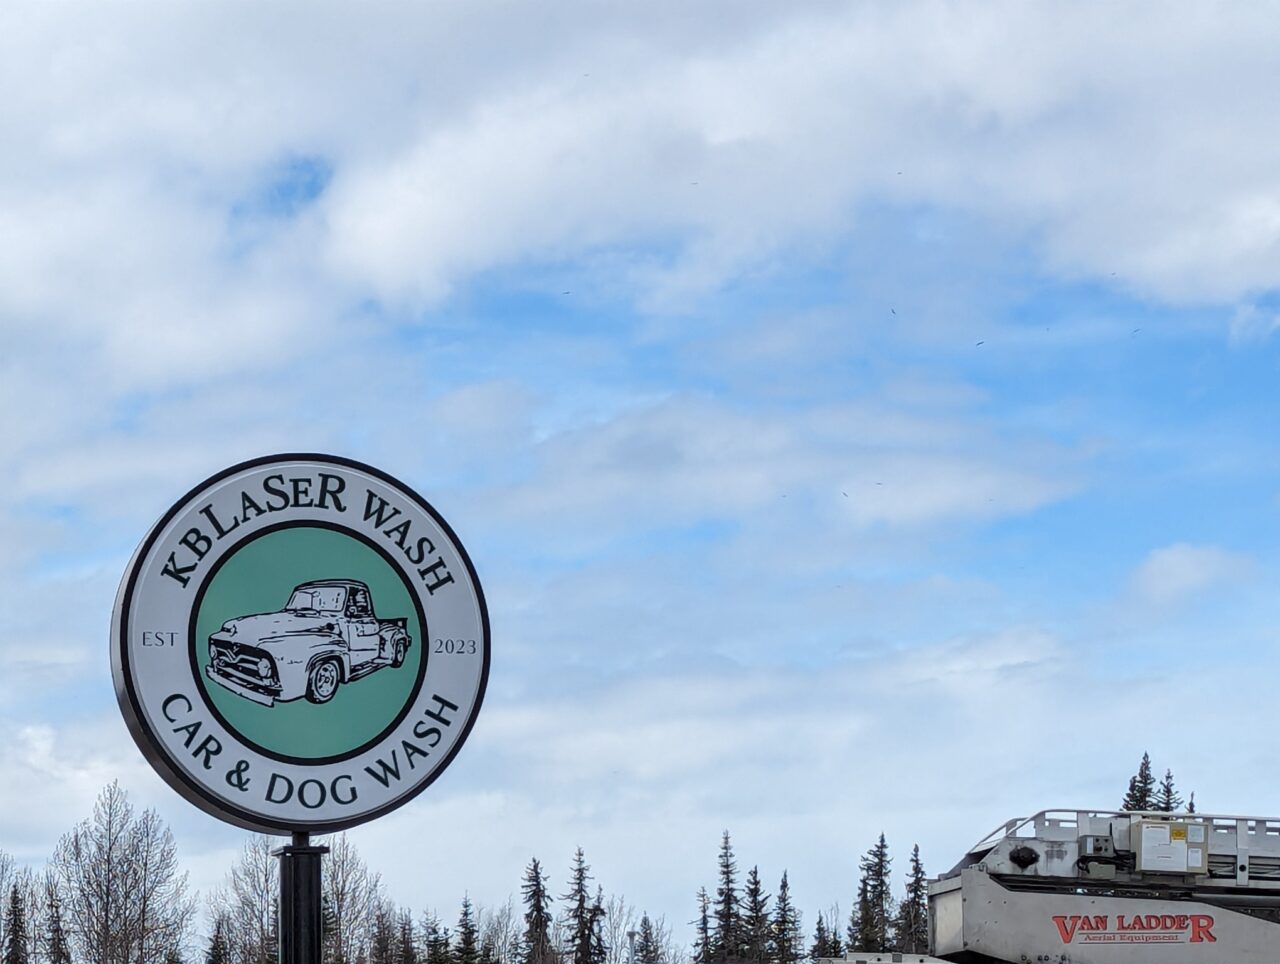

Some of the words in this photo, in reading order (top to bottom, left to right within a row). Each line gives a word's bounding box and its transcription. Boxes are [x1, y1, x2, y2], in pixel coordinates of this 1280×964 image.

[362, 489, 455, 595] WASH
[142, 631, 178, 647] EST
[434, 638, 477, 655] 2023
[162, 693, 224, 769] CAR
[225, 759, 250, 792] &
[265, 773, 358, 809] DOG
[364, 693, 459, 789] WASH
[1052, 914, 1108, 944] VAN
[1116, 914, 1217, 943] LADDER
[1120, 934, 1179, 942] Equipment
